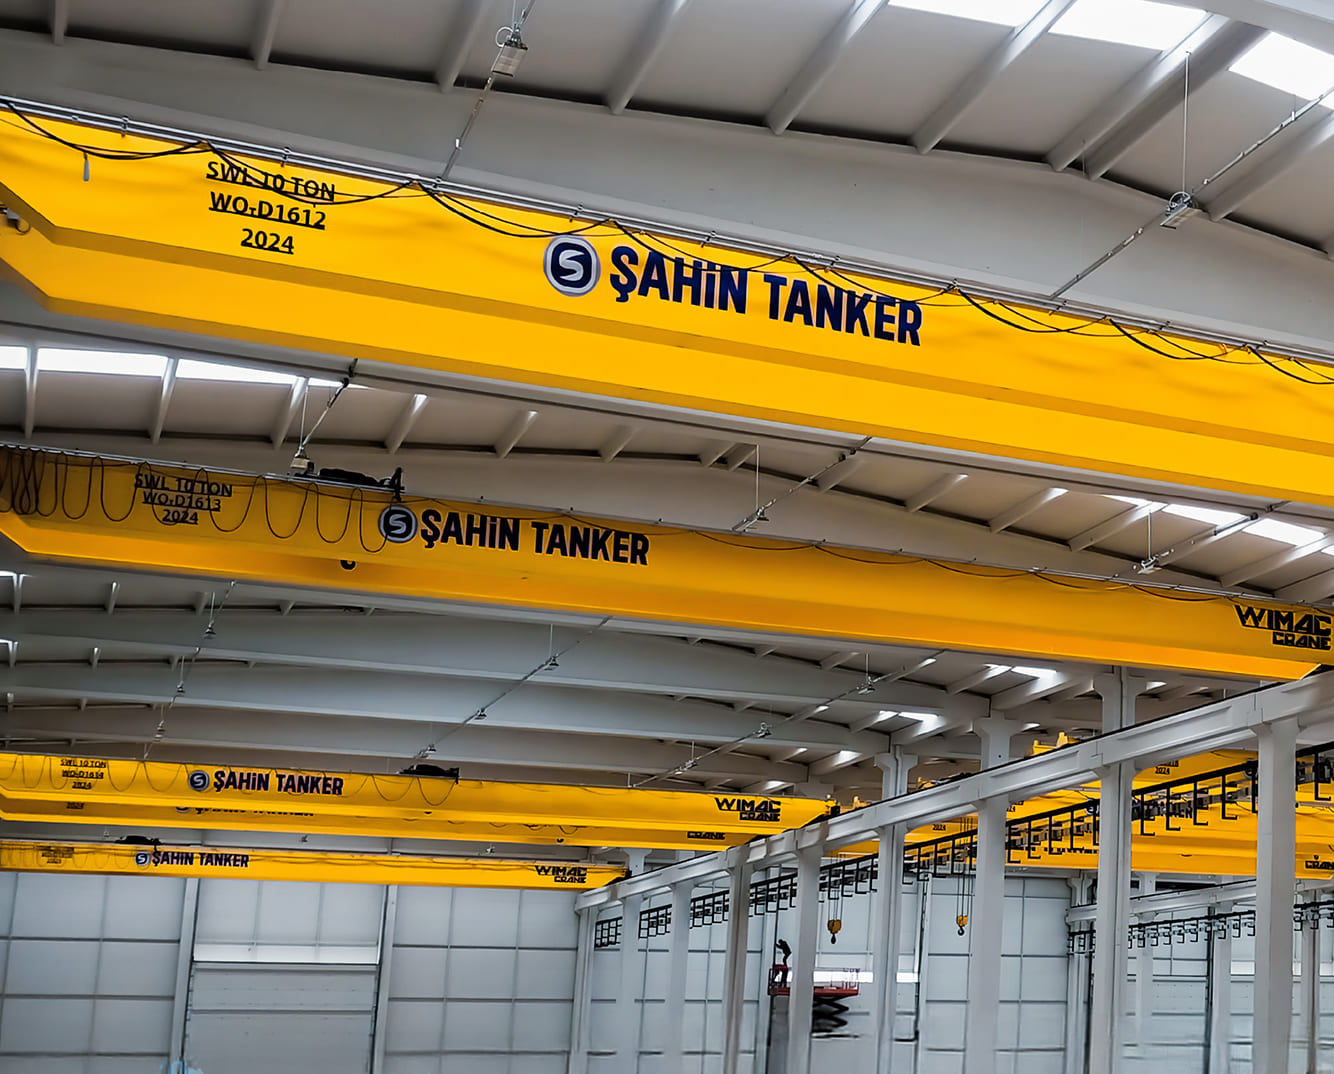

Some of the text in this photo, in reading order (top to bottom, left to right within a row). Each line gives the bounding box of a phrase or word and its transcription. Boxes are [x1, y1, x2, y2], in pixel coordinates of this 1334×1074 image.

[207, 161, 335, 202] SWL 10 TON
[241, 228, 294, 255] 2024
[764, 273, 922, 346] TANKER
[162, 508, 198, 525] 2024
[531, 521, 650, 566] TANKER
[1233, 604, 1332, 636] WIMAC
[1273, 631, 1332, 650] CRANE
[276, 774, 344, 796] TANKER
[715, 797, 781, 812] WIMAC
[739, 811, 781, 822] CRANE
[199, 852, 250, 868] TANKER
